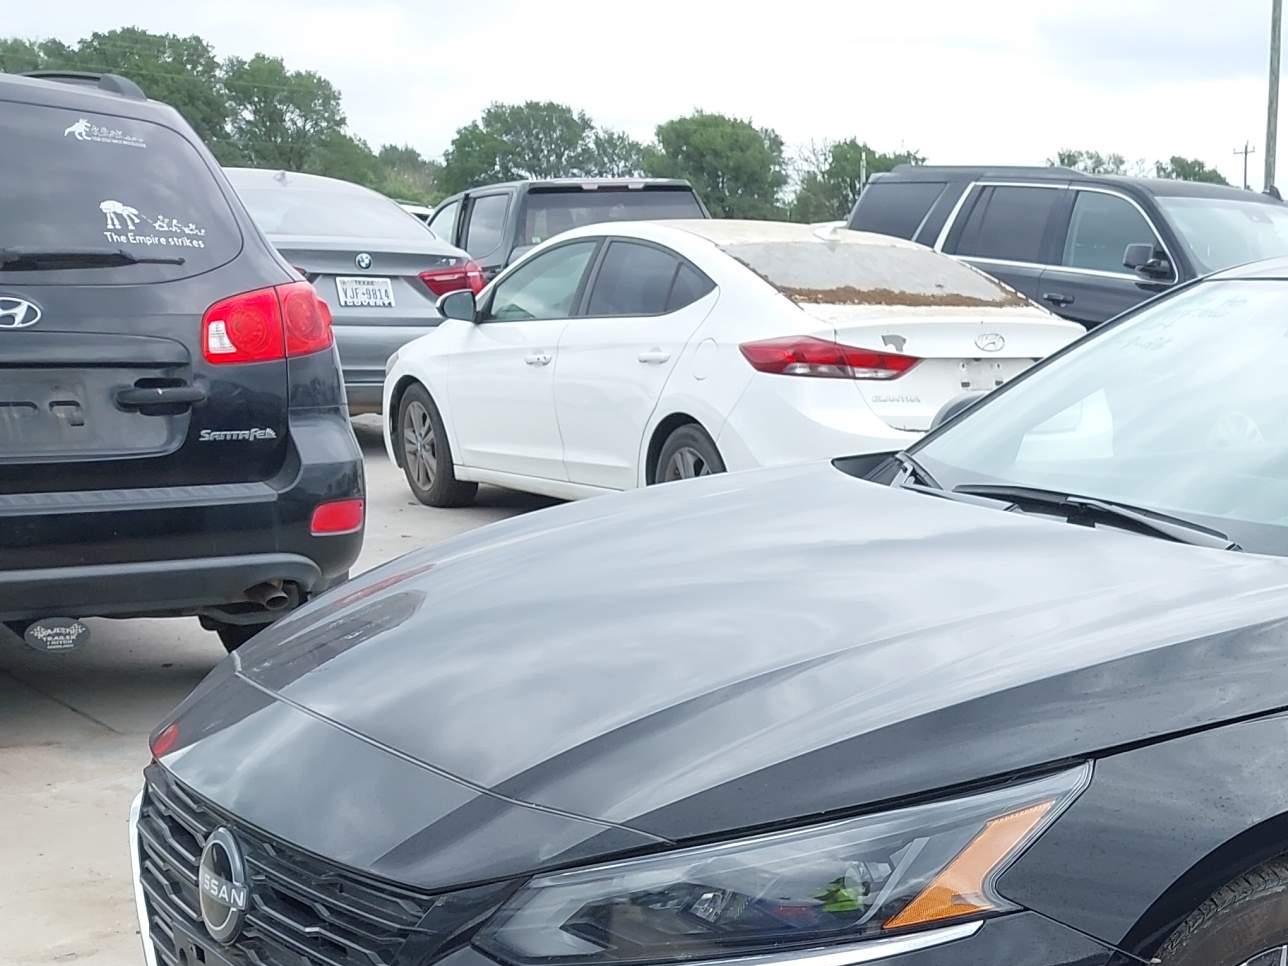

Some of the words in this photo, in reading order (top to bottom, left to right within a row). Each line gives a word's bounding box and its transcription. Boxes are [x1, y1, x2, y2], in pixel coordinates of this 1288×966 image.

[103, 231, 127, 243] The
[128, 232, 166, 247] Empire
[168, 236, 205, 249] strikes
